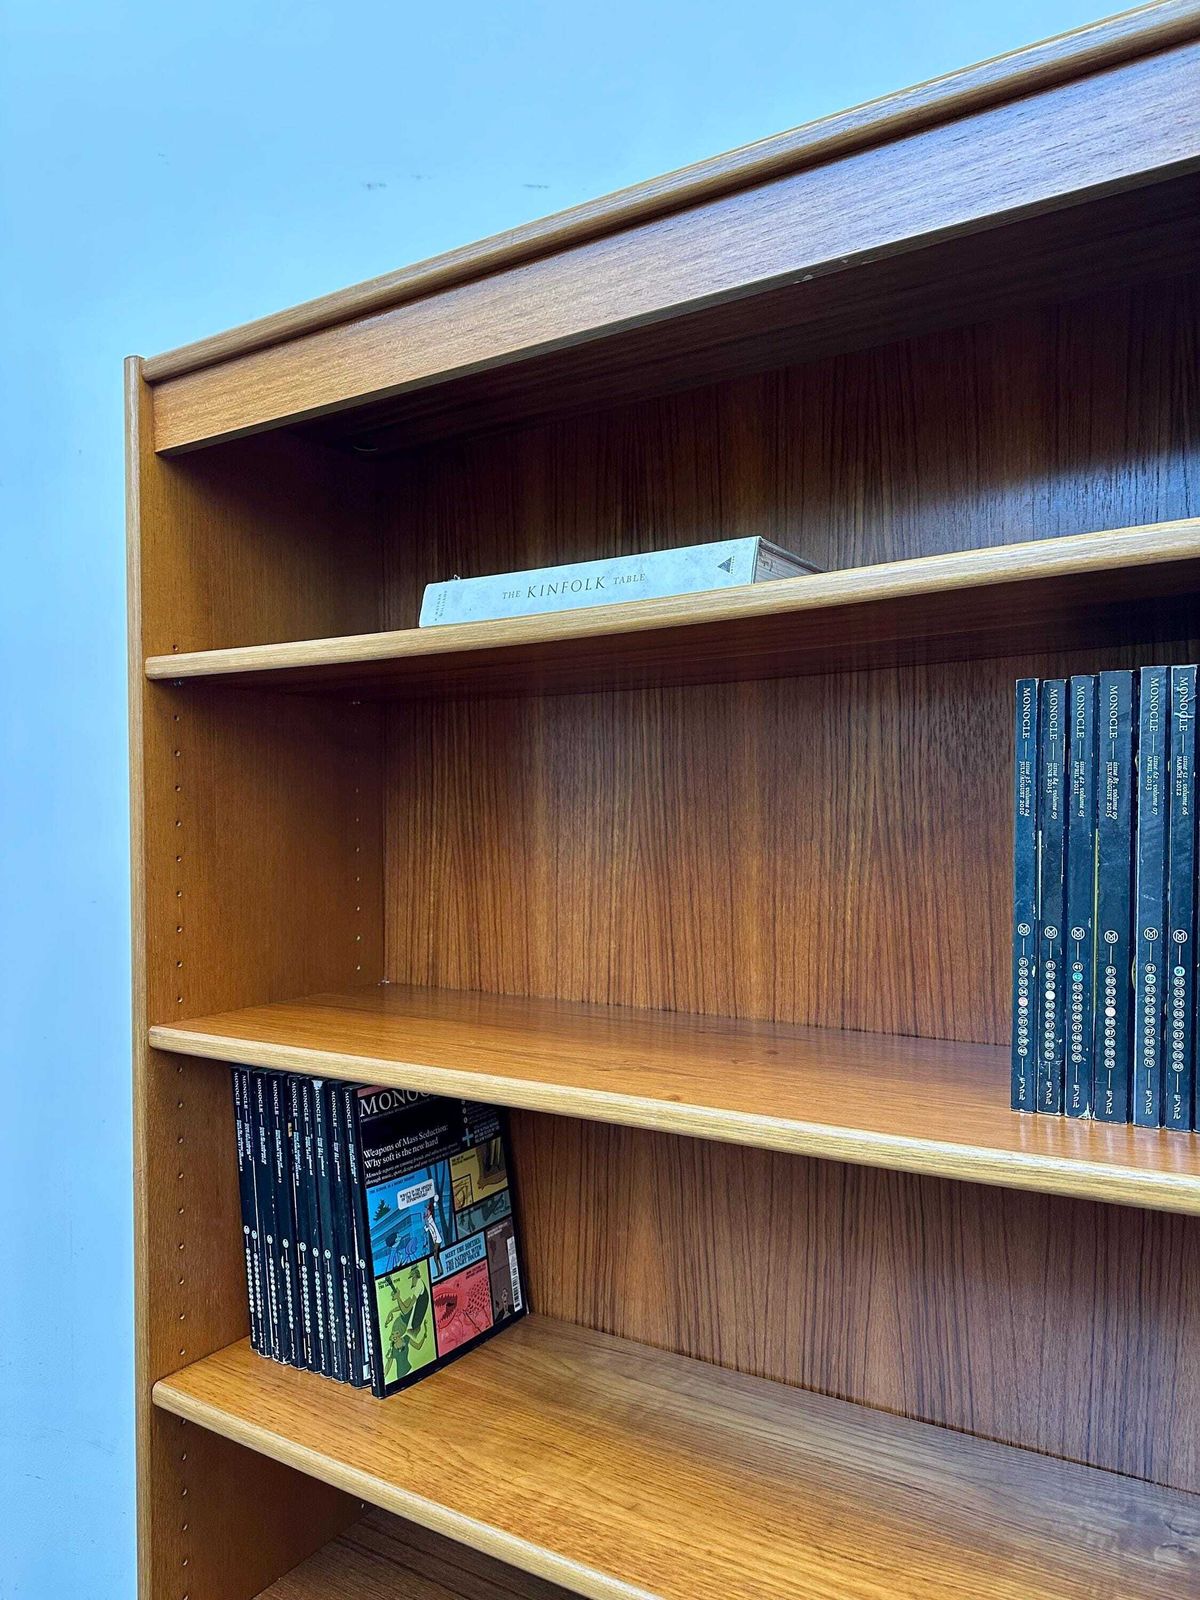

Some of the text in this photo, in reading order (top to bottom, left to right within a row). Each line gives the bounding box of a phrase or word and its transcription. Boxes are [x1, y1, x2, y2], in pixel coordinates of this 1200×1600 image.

[502, 573, 646, 600] THE KINFOLK TABLE
[1109, 686, 1117, 738] MONOCLE
[1150, 678, 1158, 732] MONOCLE
[1179, 677, 1188, 731] MONOCLE
[360, 1089, 430, 1117] MONO
[363, 1124, 449, 1159] Weapons of Mass Seduction:
[364, 1158, 382, 1169] Why
[382, 1153, 395, 1164] soft
[395, 1151, 402, 1159] is
[401, 1147, 412, 1157] the
[412, 1145, 425, 1153] new
[425, 1136, 439, 1148] hard
